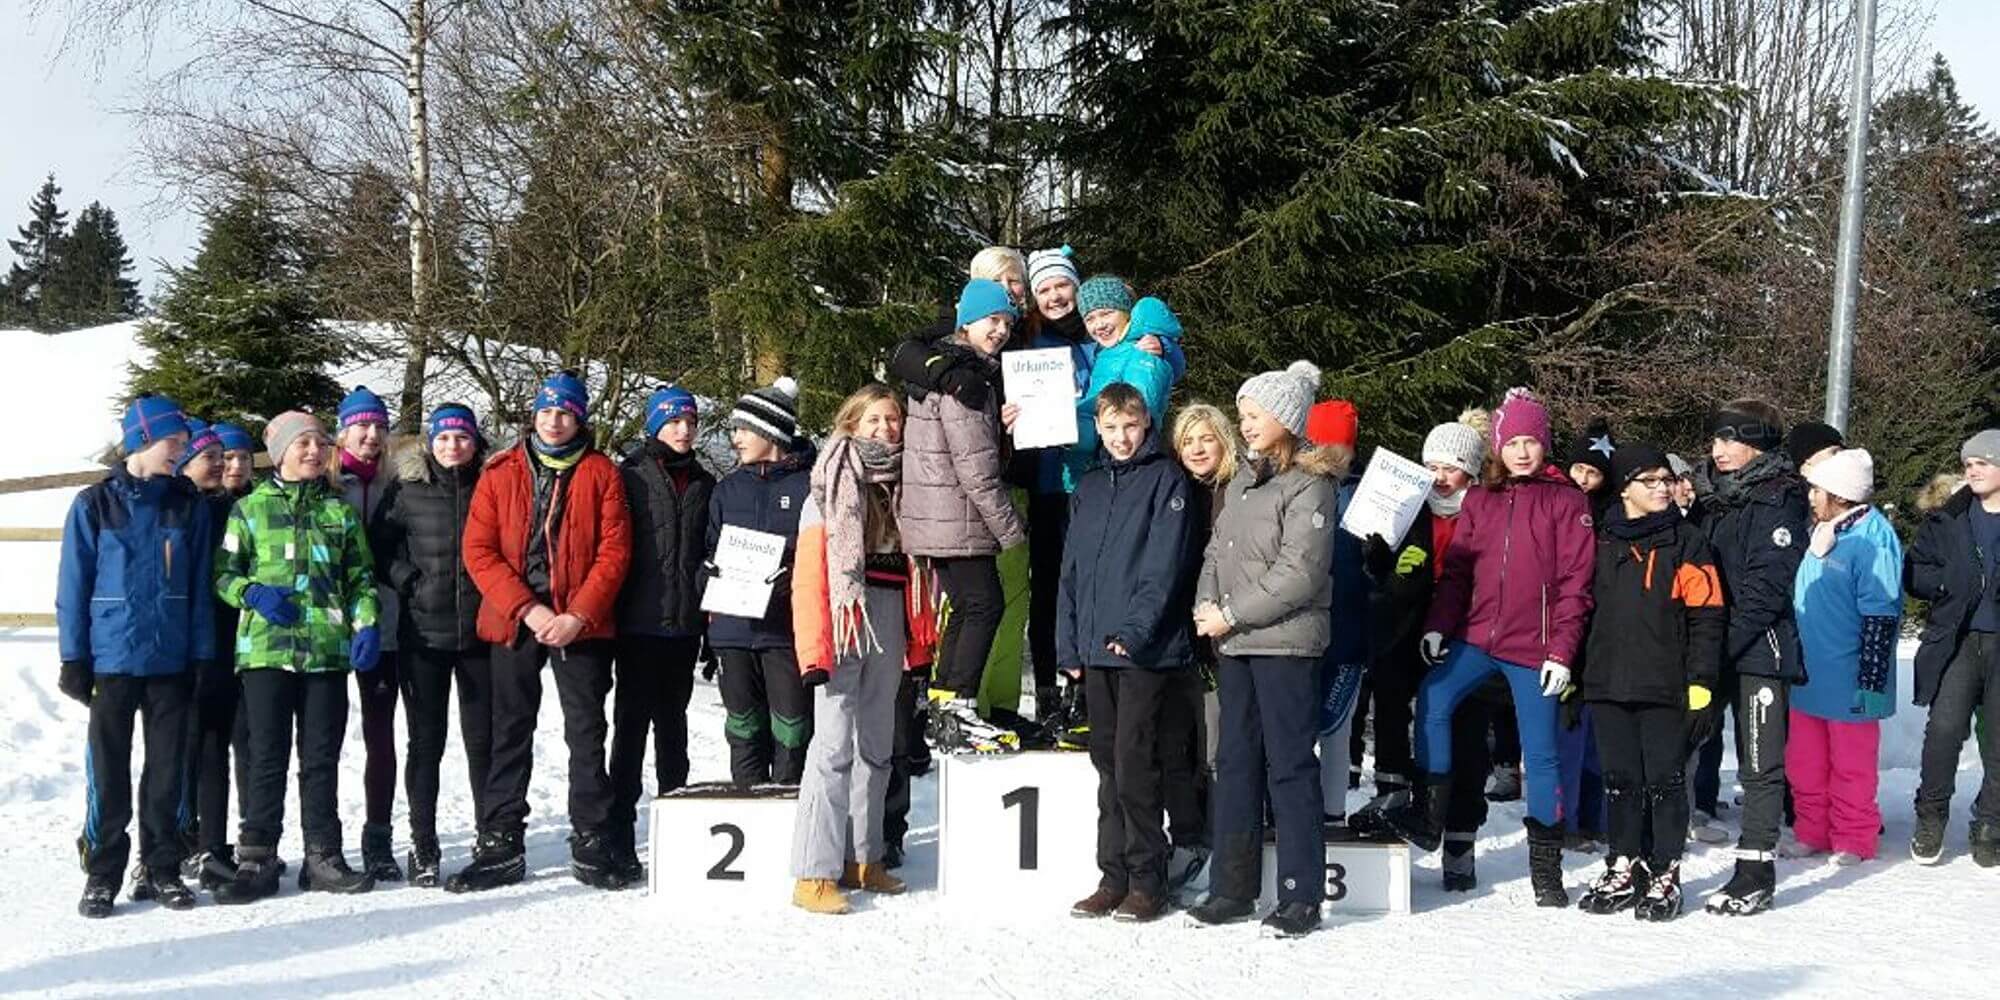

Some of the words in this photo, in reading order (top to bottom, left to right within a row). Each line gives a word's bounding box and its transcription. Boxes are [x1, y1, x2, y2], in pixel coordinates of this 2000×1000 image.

[1011, 359, 1065, 373] Urkunde
[1380, 458, 1427, 490] Urkunde
[728, 535, 777, 556] Urkunde
[1001, 786, 1039, 870] 1
[706, 822, 745, 881] 2
[1323, 863, 1347, 901] 3
